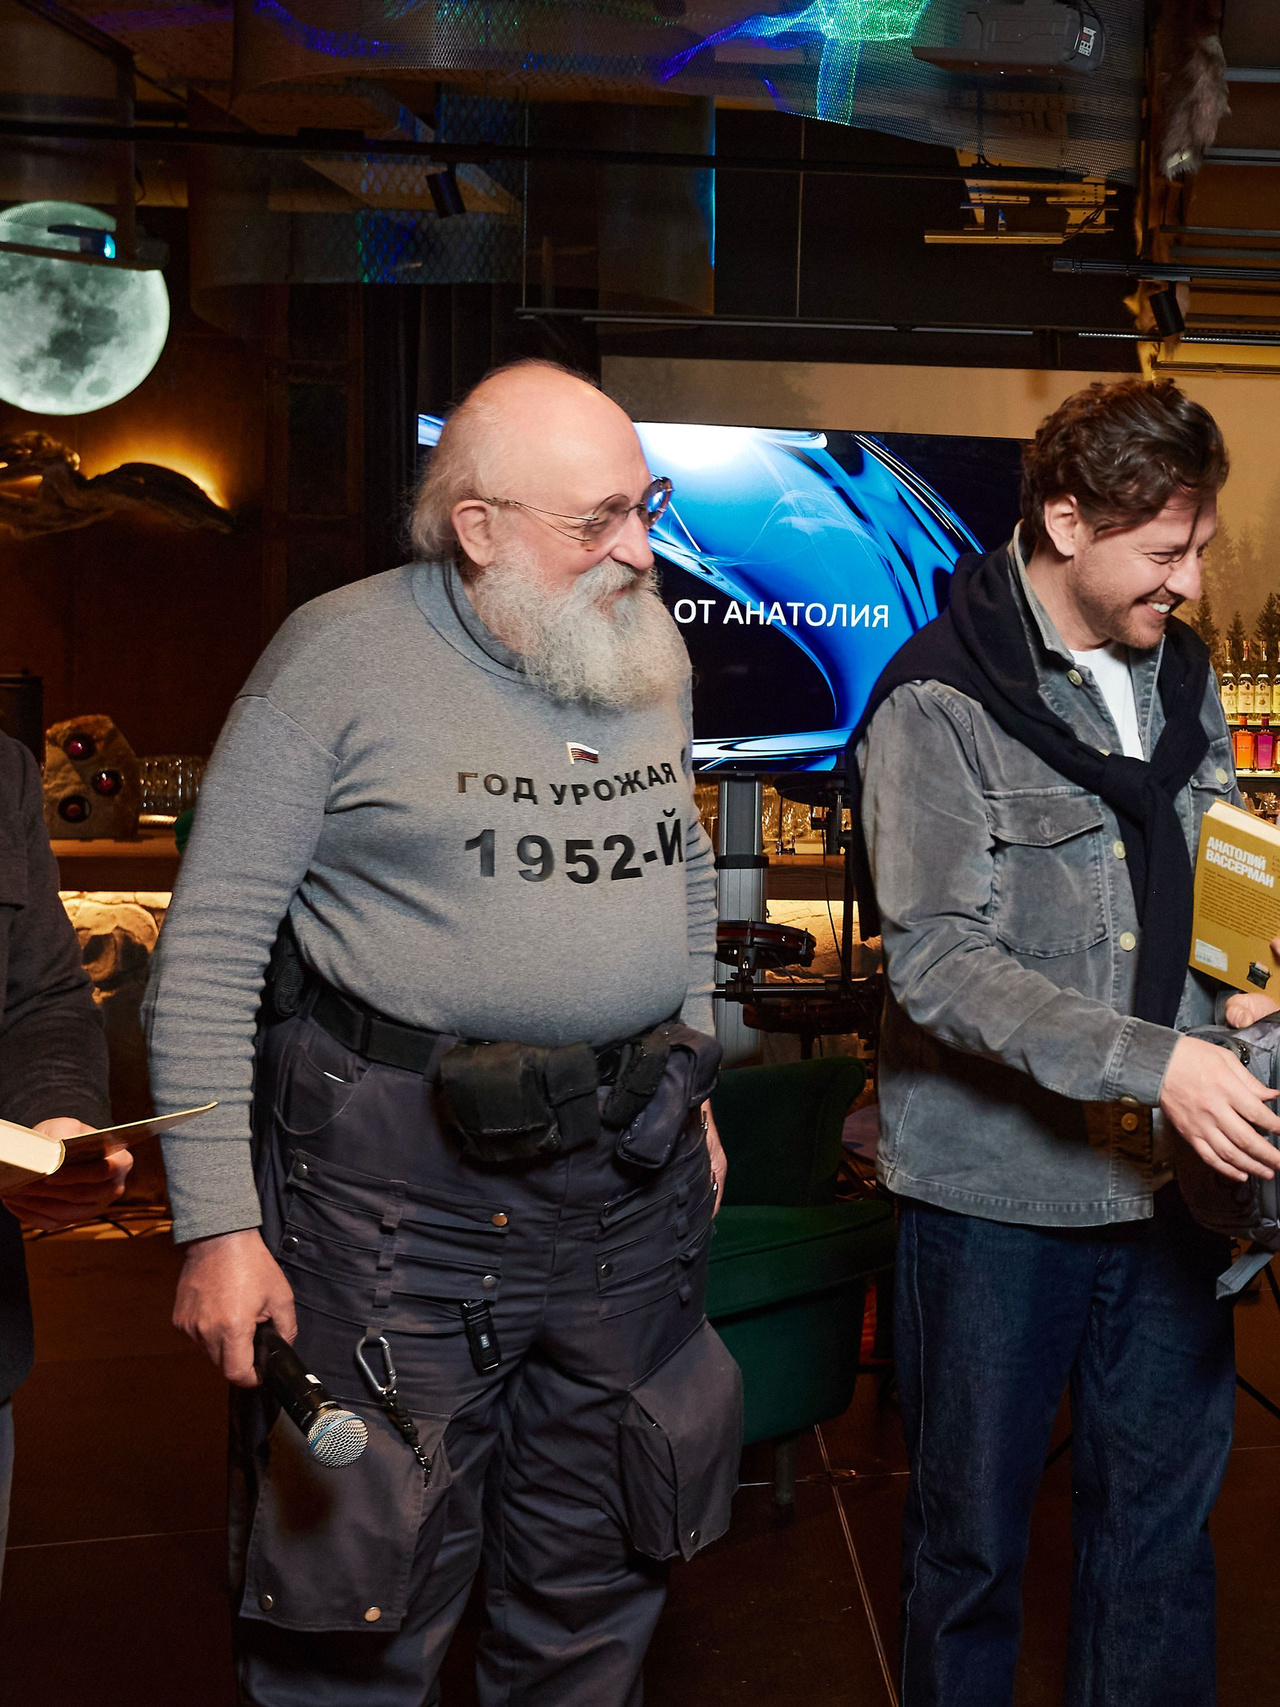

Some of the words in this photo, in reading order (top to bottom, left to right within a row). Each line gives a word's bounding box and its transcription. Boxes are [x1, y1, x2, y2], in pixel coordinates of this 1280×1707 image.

[674, 598, 716, 625] ОТ
[722, 601, 889, 628] АНАТОЛИЯ
[457, 771, 539, 805] ГОД
[549, 762, 677, 806] УРОЖАЯ
[465, 807, 684, 885] 1952-Й
[1206, 836, 1267, 871] АНАТОЛИЙ
[1205, 848, 1275, 888] ВАССЕРМАН
